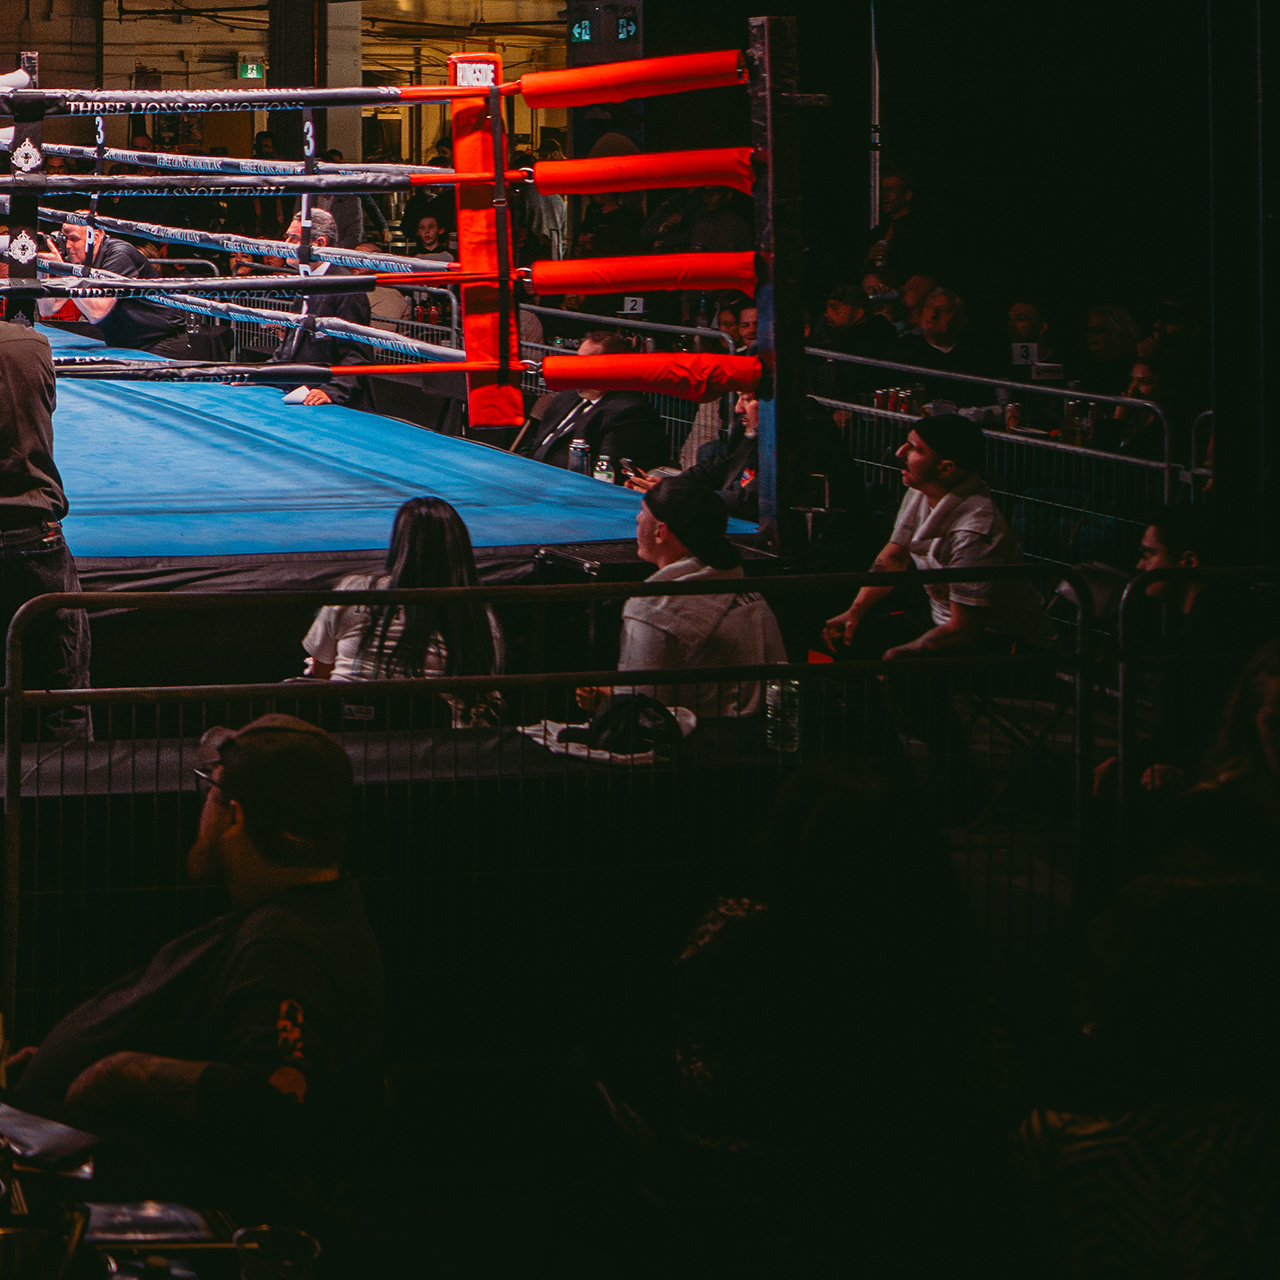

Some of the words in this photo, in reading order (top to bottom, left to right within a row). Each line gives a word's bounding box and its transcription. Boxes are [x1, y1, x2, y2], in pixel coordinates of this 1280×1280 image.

[66, 101, 126, 114] THREE
[130, 102, 185, 114] LIONS
[188, 101, 306, 113] PROMOTIONS
[95, 115, 104, 145] 3
[303, 121, 316, 157] 3
[65, 287, 126, 298] THREE
[129, 288, 184, 299] LIONS
[186, 288, 305, 299] PROMOTIONS
[630, 299, 638, 311] 2
[1020, 344, 1029, 359] 3
